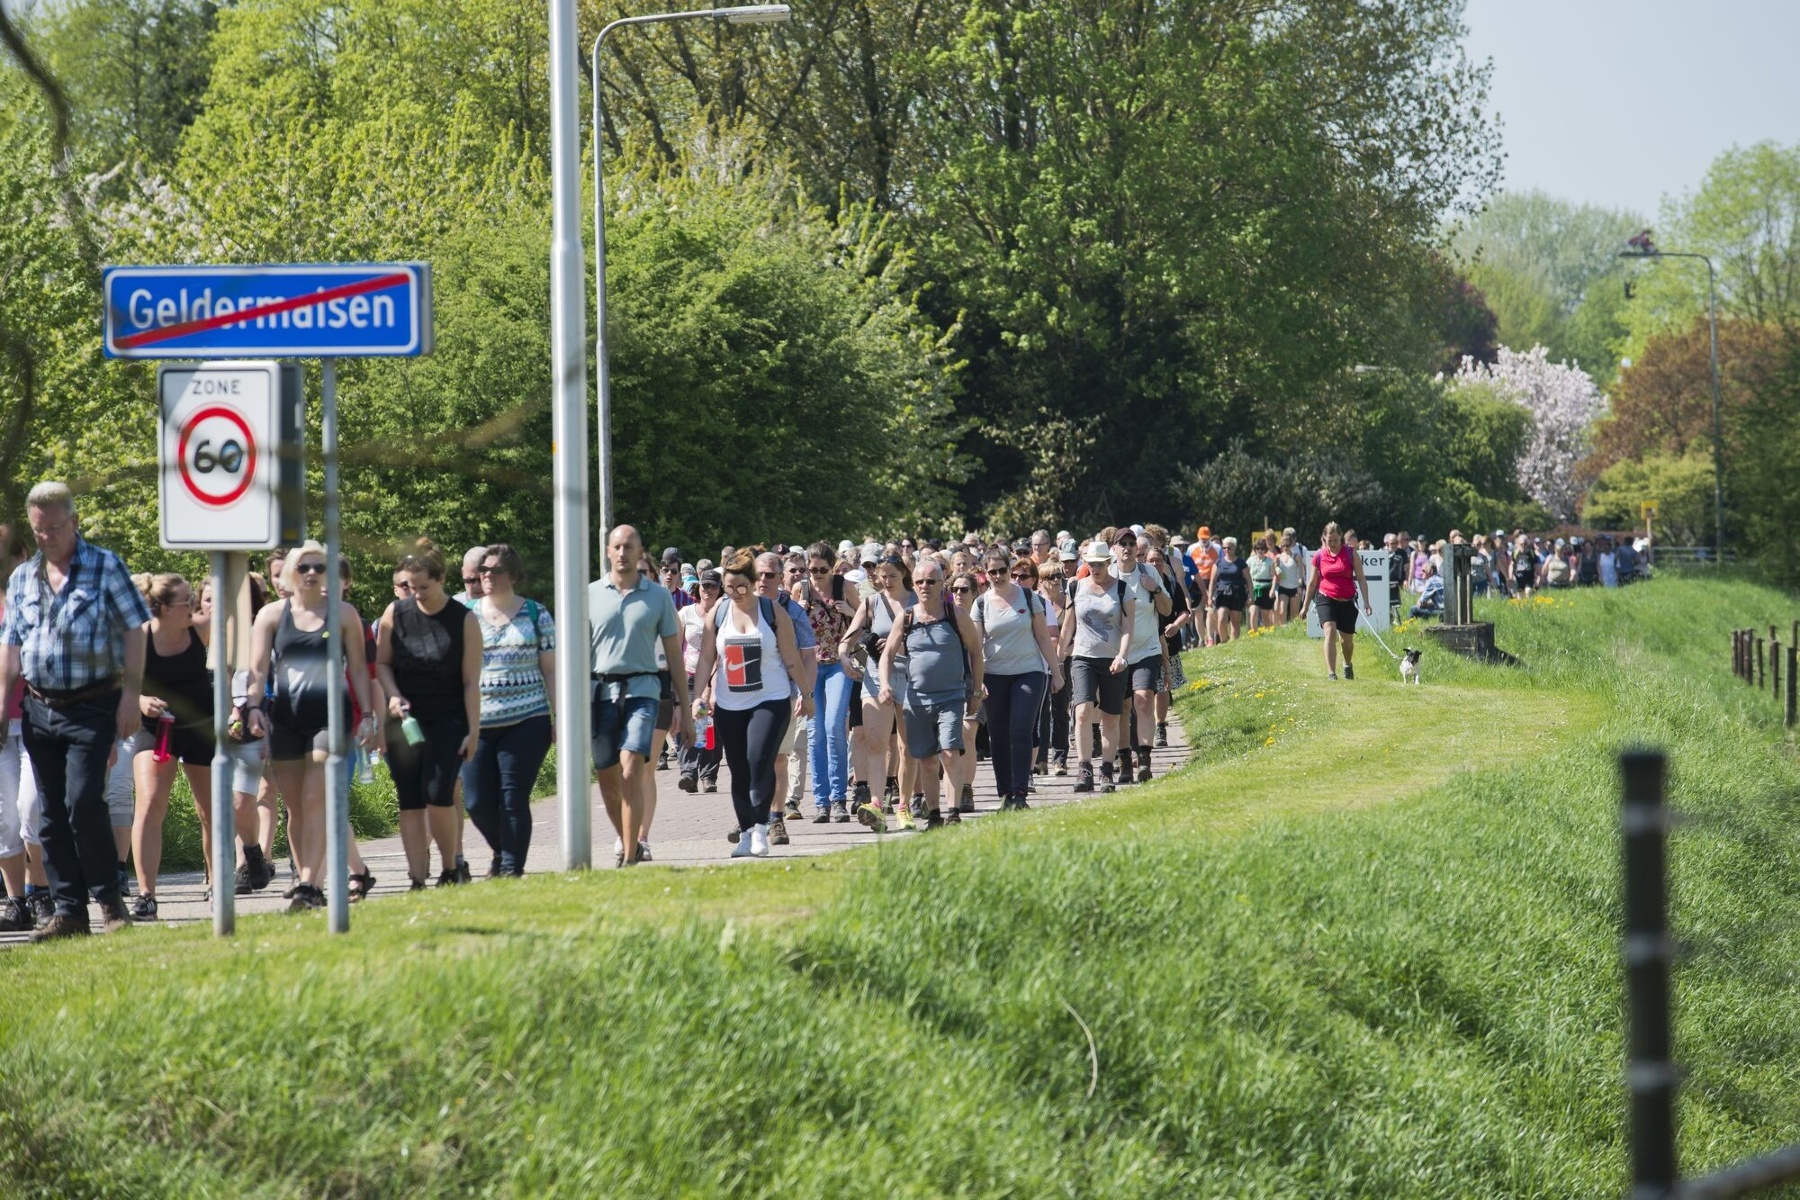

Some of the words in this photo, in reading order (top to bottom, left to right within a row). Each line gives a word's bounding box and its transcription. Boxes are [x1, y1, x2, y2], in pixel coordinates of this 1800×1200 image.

[129, 286, 395, 329] Geldermalsen
[192, 379, 241, 395] ZONE
[194, 439, 243, 474] 60
